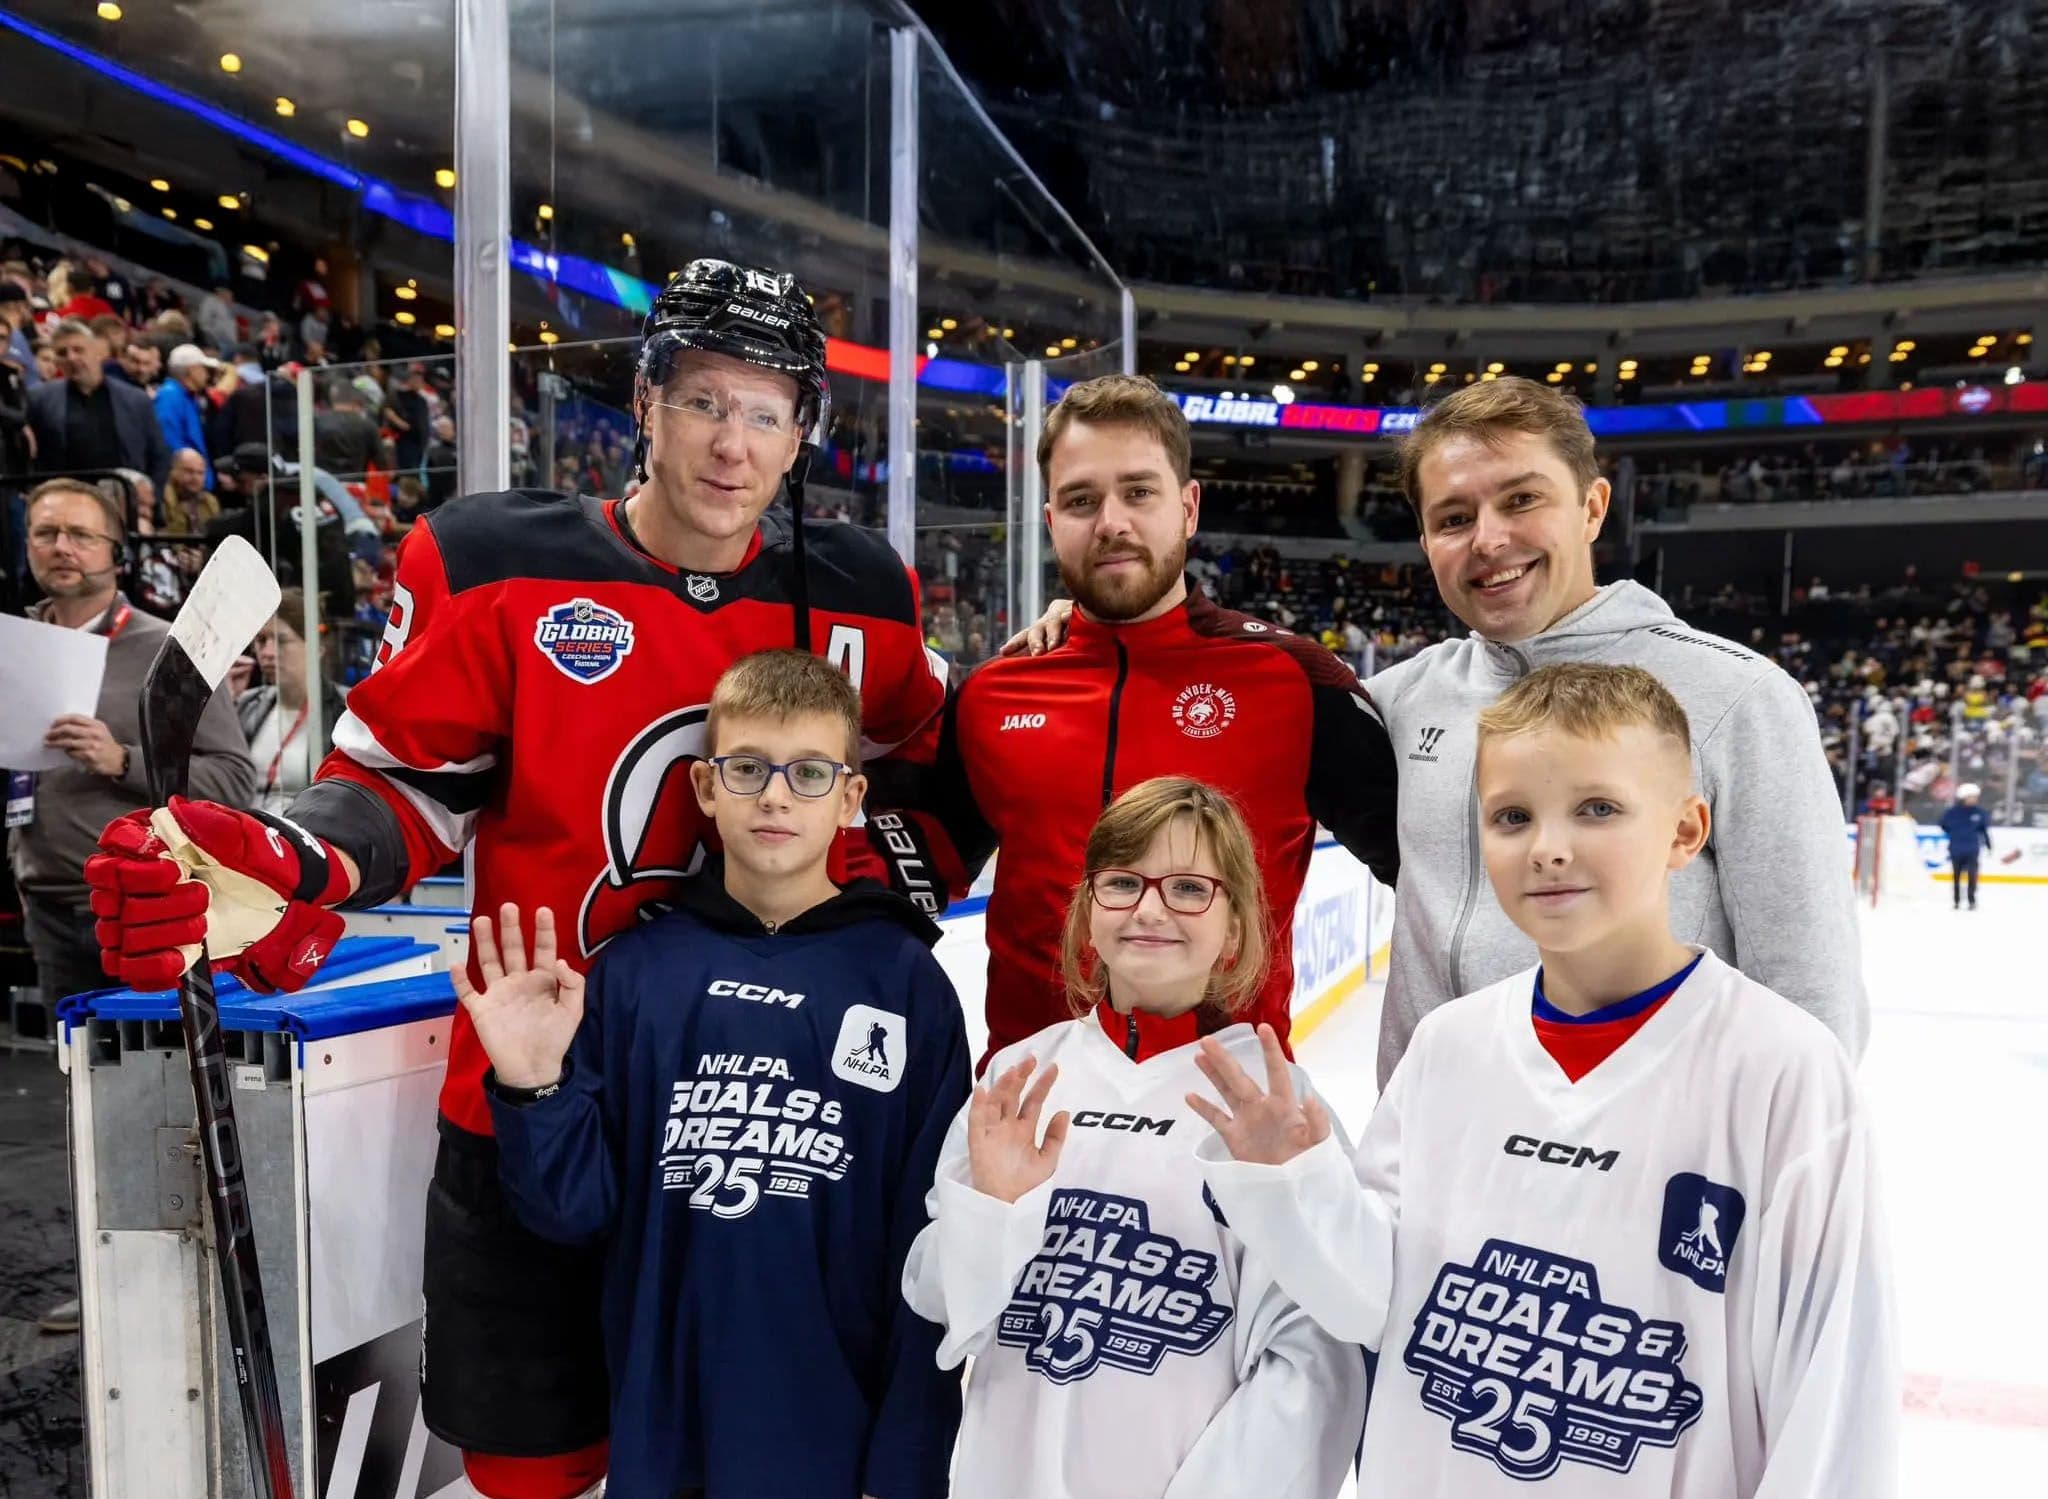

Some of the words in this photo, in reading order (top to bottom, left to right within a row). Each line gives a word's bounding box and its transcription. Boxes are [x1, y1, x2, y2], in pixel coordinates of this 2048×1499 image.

[745, 268, 781, 297] 18
[1182, 395, 1279, 425] GLOBAL
[541, 623, 629, 644] GLOBAL
[555, 641, 613, 654] SERIES
[827, 624, 865, 696] A
[1000, 713, 1047, 732] JAKO
[707, 979, 806, 1009] CCM
[696, 1053, 794, 1081] NHLPA
[842, 1055, 892, 1081] NHLPA
[820, 1100, 843, 1125] &
[1071, 1111, 1176, 1136] CCM
[661, 1117, 844, 1166] DREAMS
[1503, 1134, 1621, 1172] CCM
[689, 1153, 765, 1219] 25
[767, 1175, 809, 1193] 1999
[1050, 1196, 1141, 1231] NHLPA
[1040, 1223, 1173, 1279] OALS
[1175, 1255, 1208, 1283] &
[1673, 1242, 1727, 1277] NHLPA
[1483, 1249, 1591, 1300] NHLPA
[1012, 1260, 1203, 1326] REAMS
[1435, 1271, 1633, 1356] GOALS
[1636, 1327, 1674, 1357] &
[1002, 1316, 1033, 1331] EST.
[1030, 1301, 1103, 1370] 25
[1106, 1334, 1153, 1356] 1999
[1417, 1311, 1675, 1413] DREAMS
[1431, 1380, 1461, 1402] EST.
[1458, 1377, 1557, 1465] 25
[1565, 1424, 1622, 1451] 1999
